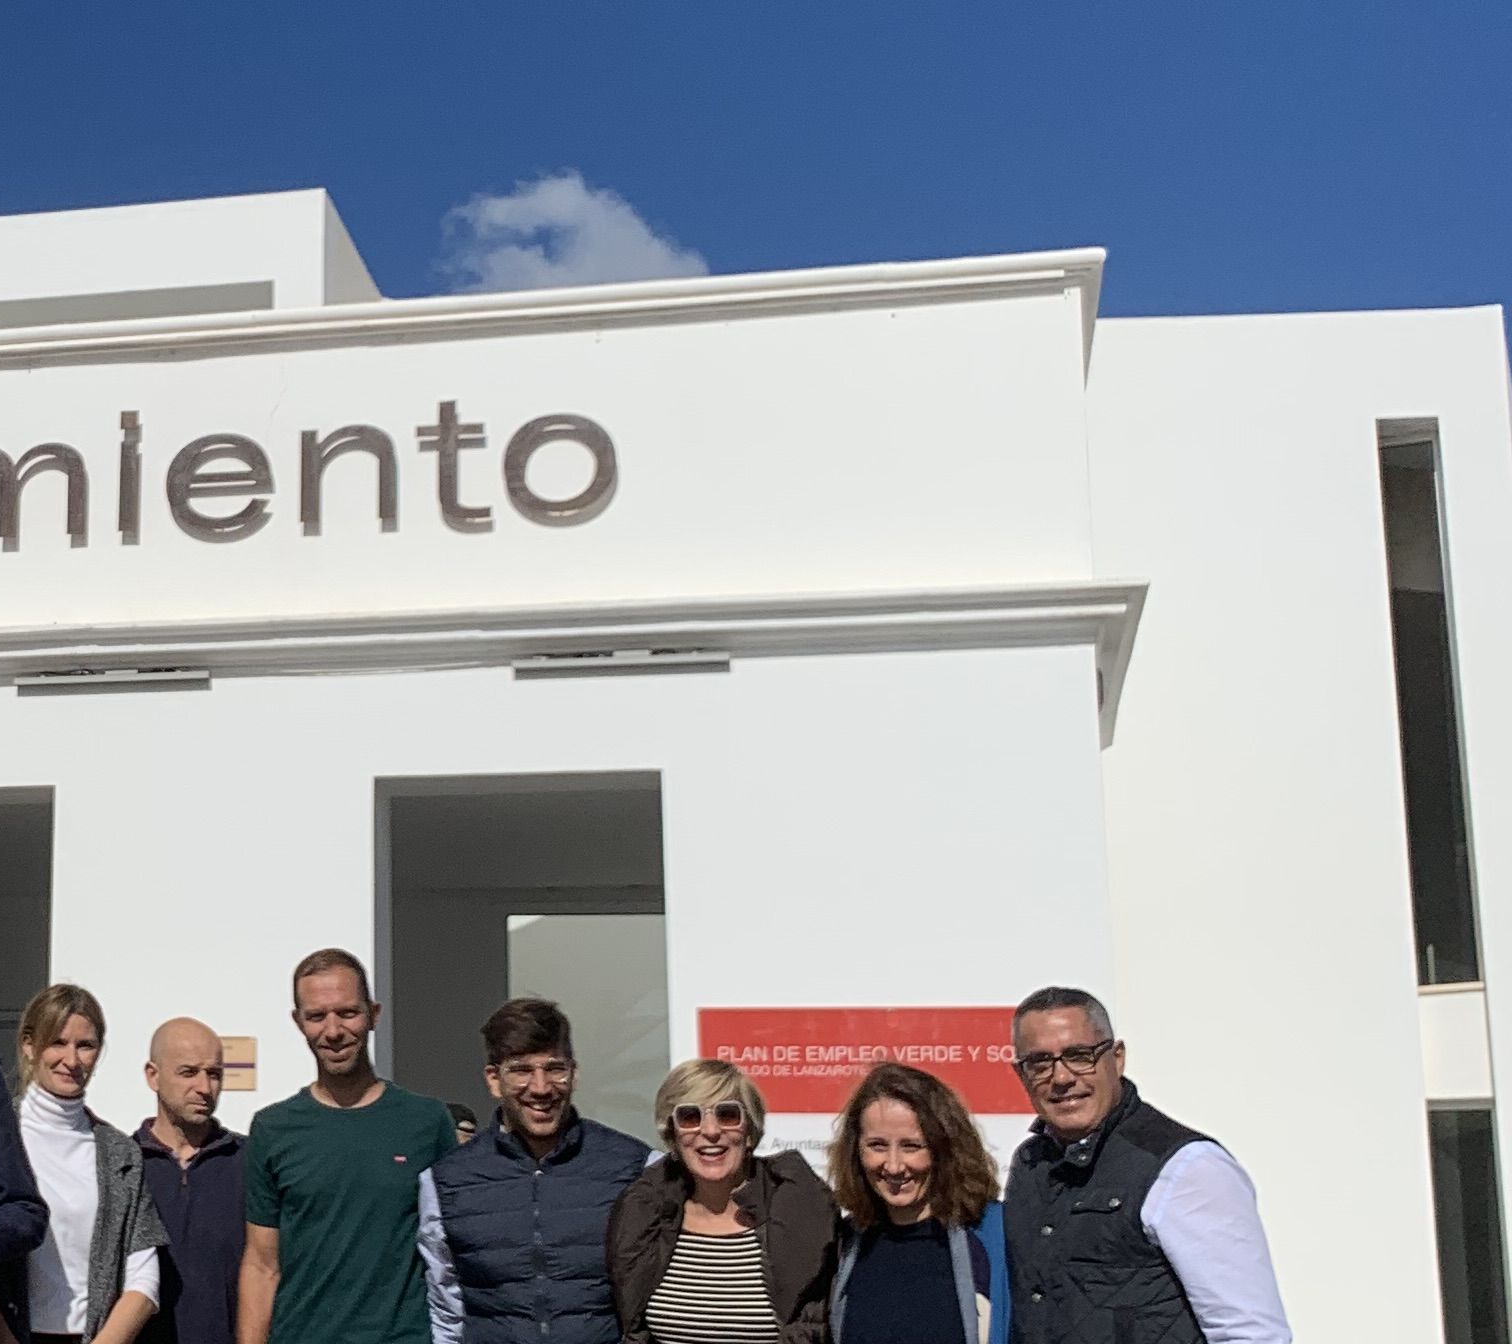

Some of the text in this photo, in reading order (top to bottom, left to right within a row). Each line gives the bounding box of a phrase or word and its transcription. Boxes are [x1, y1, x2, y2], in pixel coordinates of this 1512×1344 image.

[717, 1045, 768, 1062] PLAN
[773, 1045, 801, 1062] DE
[805, 1045, 888, 1062] EMPLEO
[893, 1044, 962, 1062] VERDE
[967, 1045, 981, 1062] Y
[773, 1064, 792, 1076] DE
